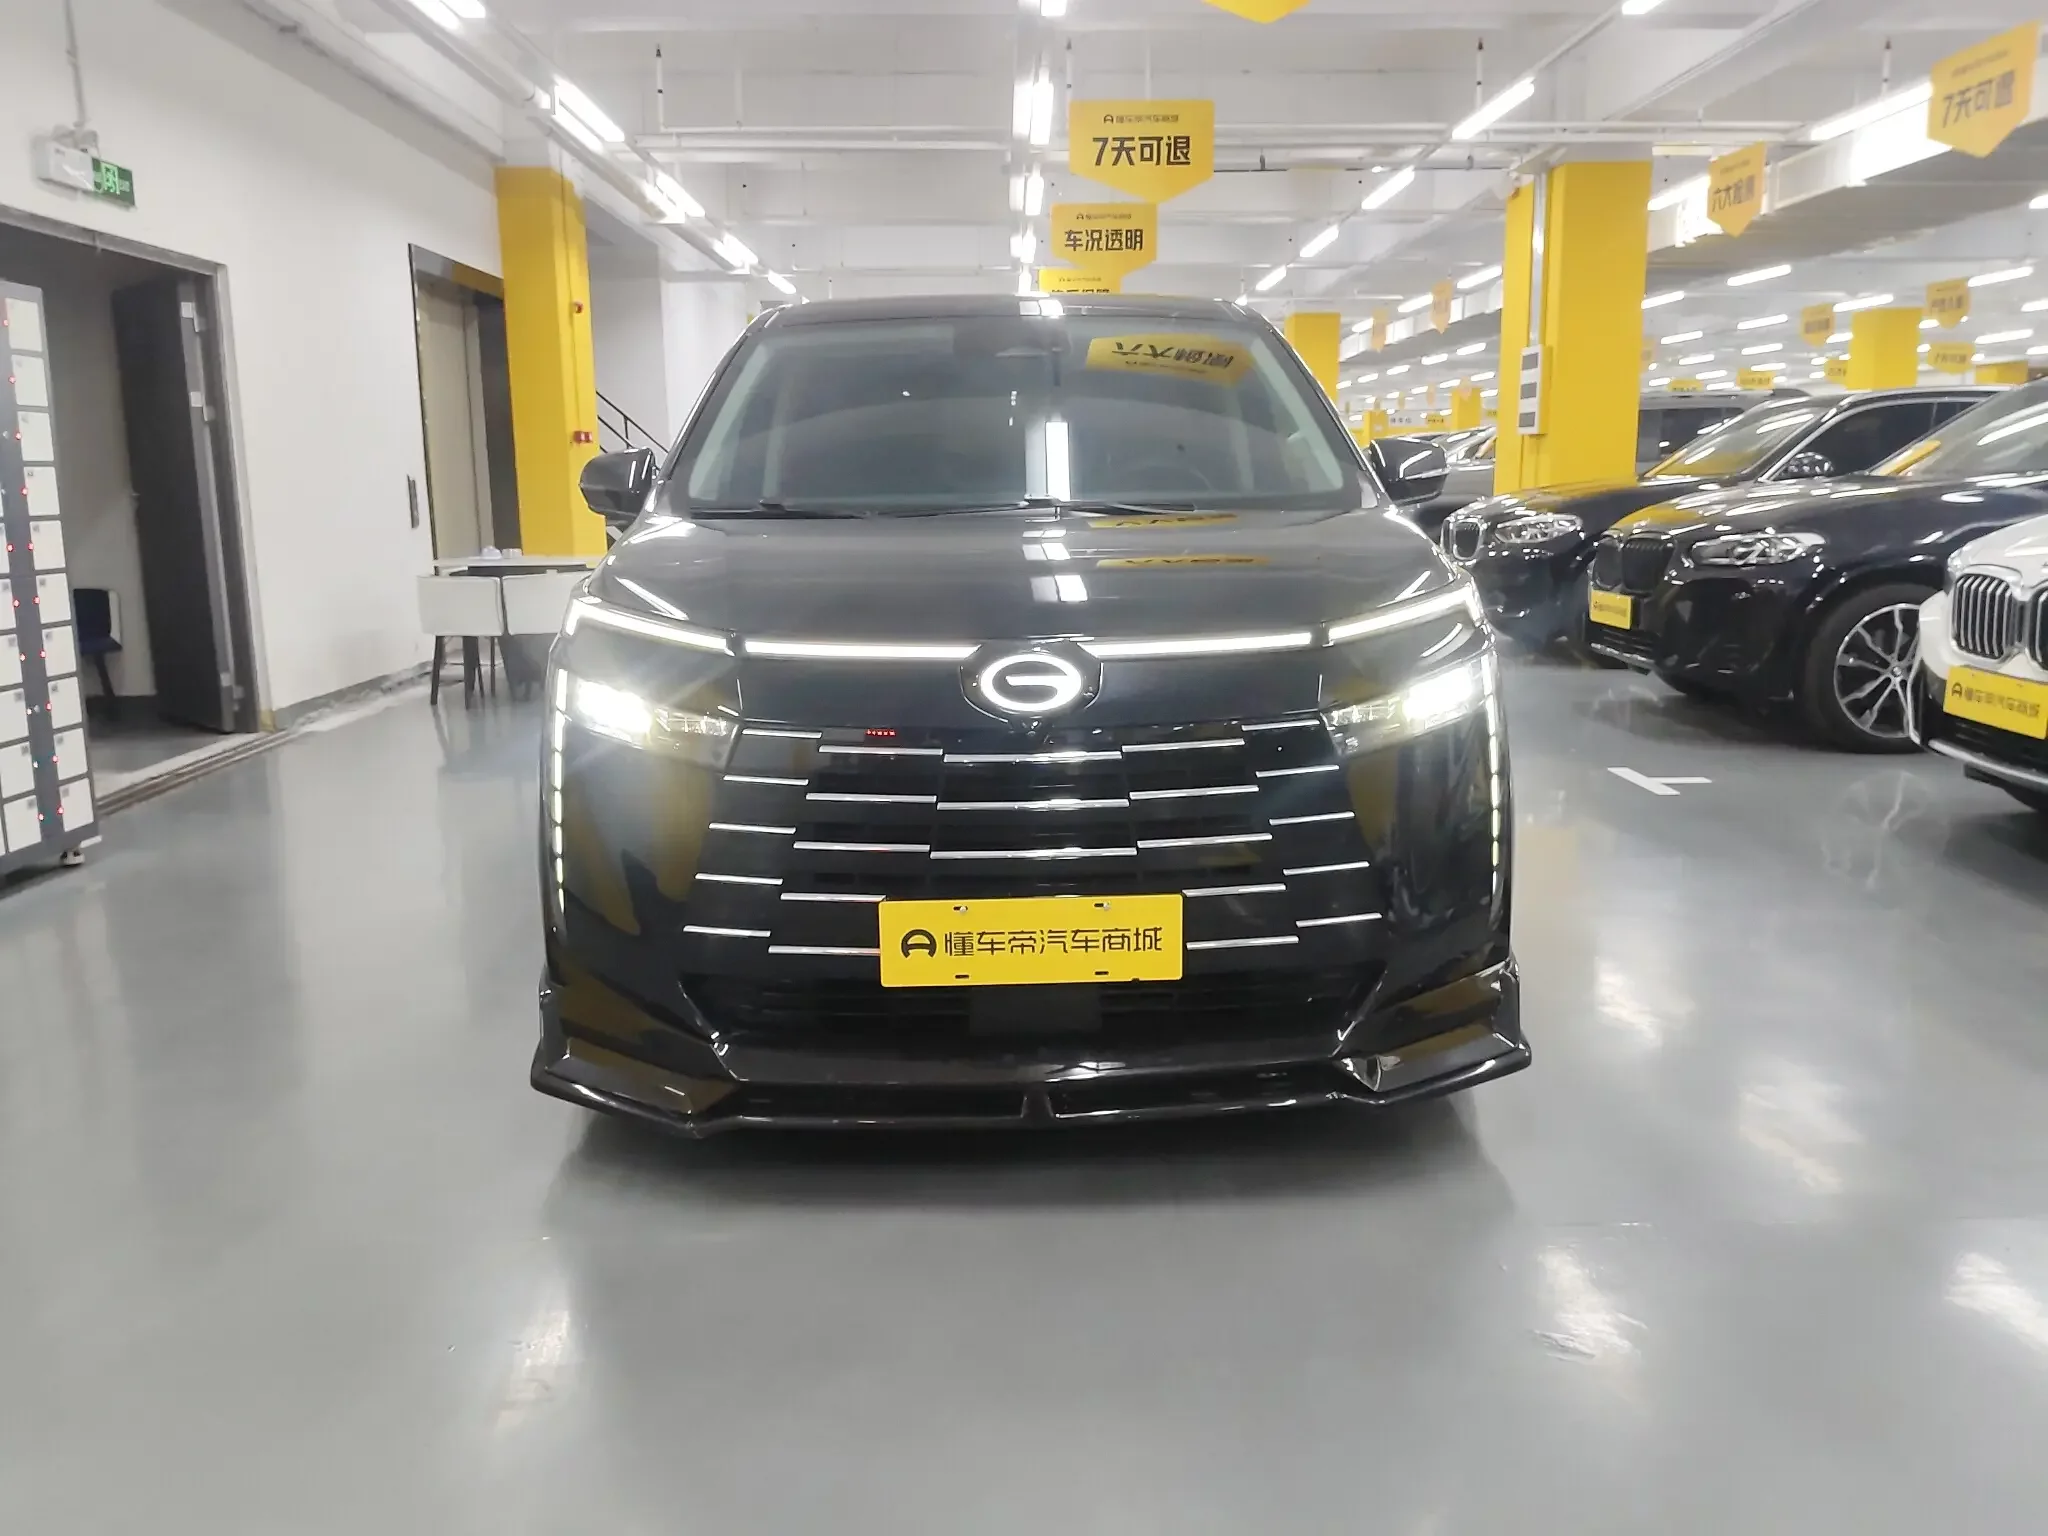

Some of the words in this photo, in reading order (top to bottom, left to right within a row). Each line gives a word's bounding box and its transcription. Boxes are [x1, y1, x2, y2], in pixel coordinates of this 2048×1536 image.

[1092, 136, 1191, 166] 7天可退
[1064, 228, 1144, 252] 车况透明
[944, 927, 1163, 957] 懂车帝汽车商城
